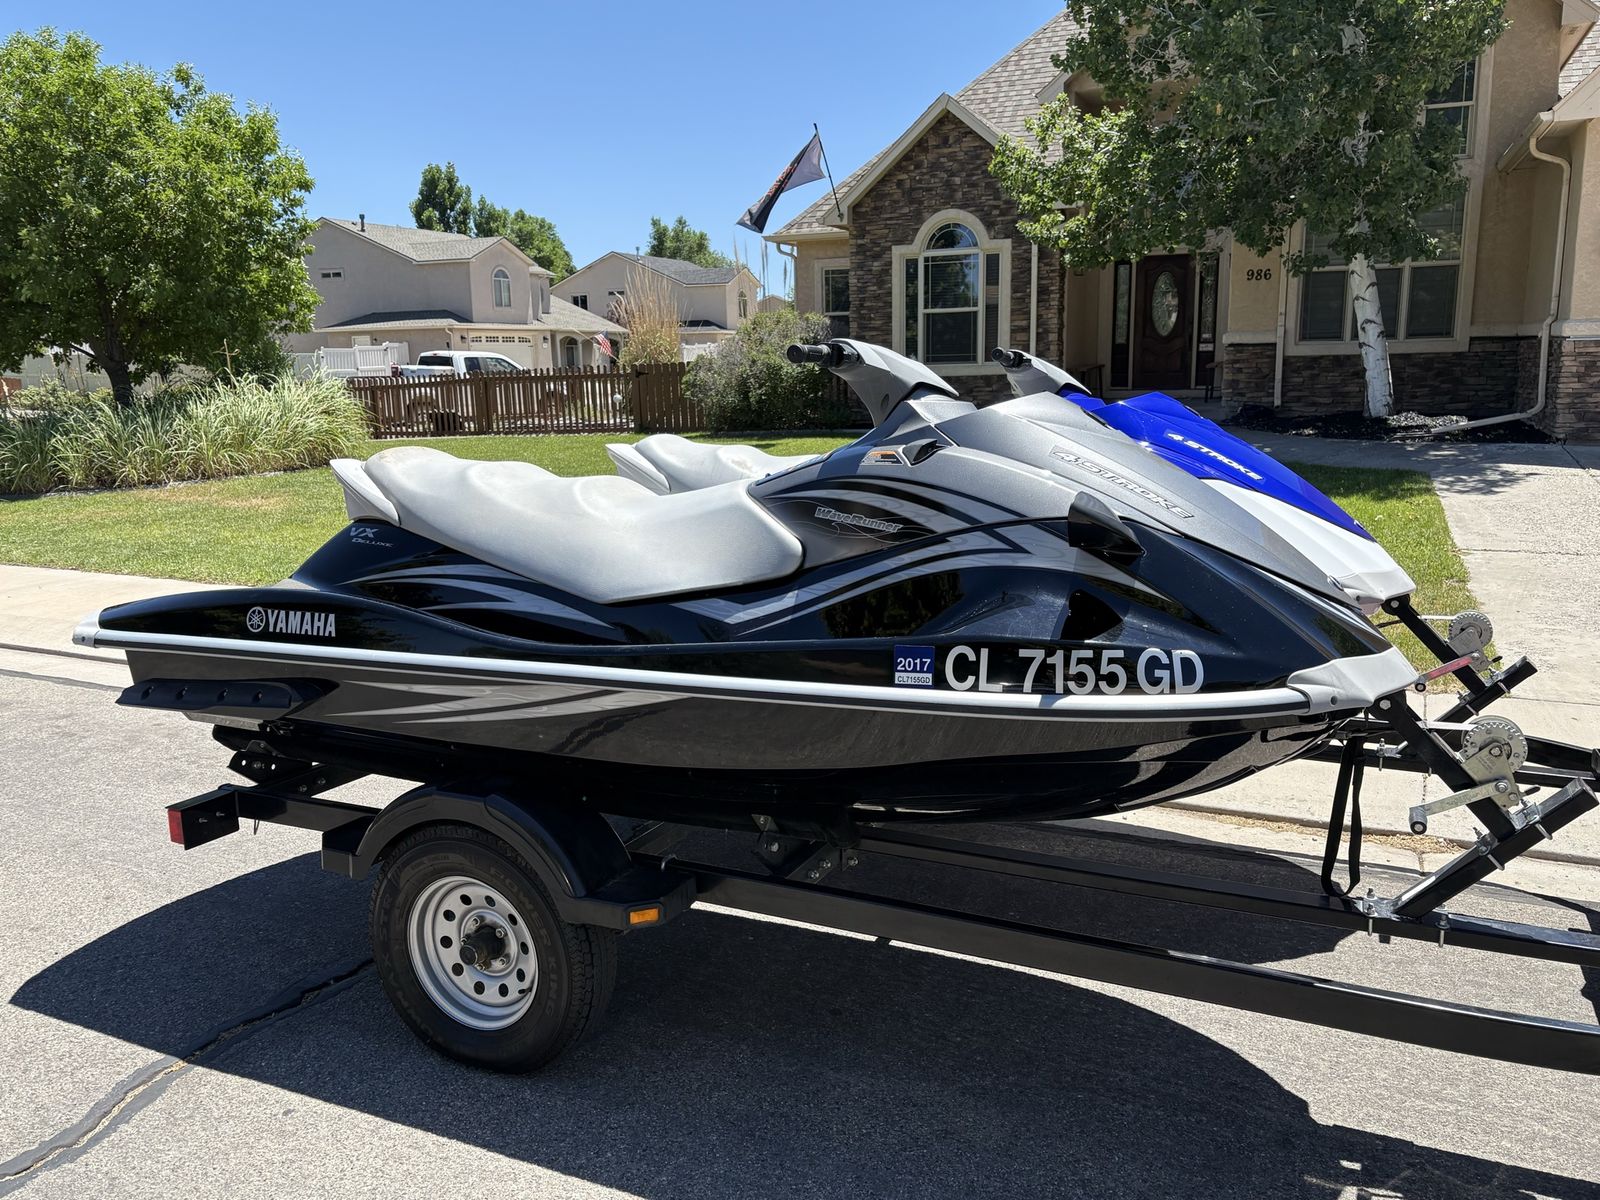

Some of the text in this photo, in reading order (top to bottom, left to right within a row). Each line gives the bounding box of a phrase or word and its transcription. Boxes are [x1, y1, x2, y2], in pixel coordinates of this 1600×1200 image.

[1246, 268, 1272, 281] 986
[814, 506, 904, 533] WaveRunner
[350, 527, 380, 538] VX
[267, 609, 337, 638] YAMAHA
[896, 657, 932, 672] 2017
[944, 645, 1205, 695] CL 7155 GD
[897, 675, 931, 684] CL7155GD
[488, 866, 560, 1017] POWER KING
